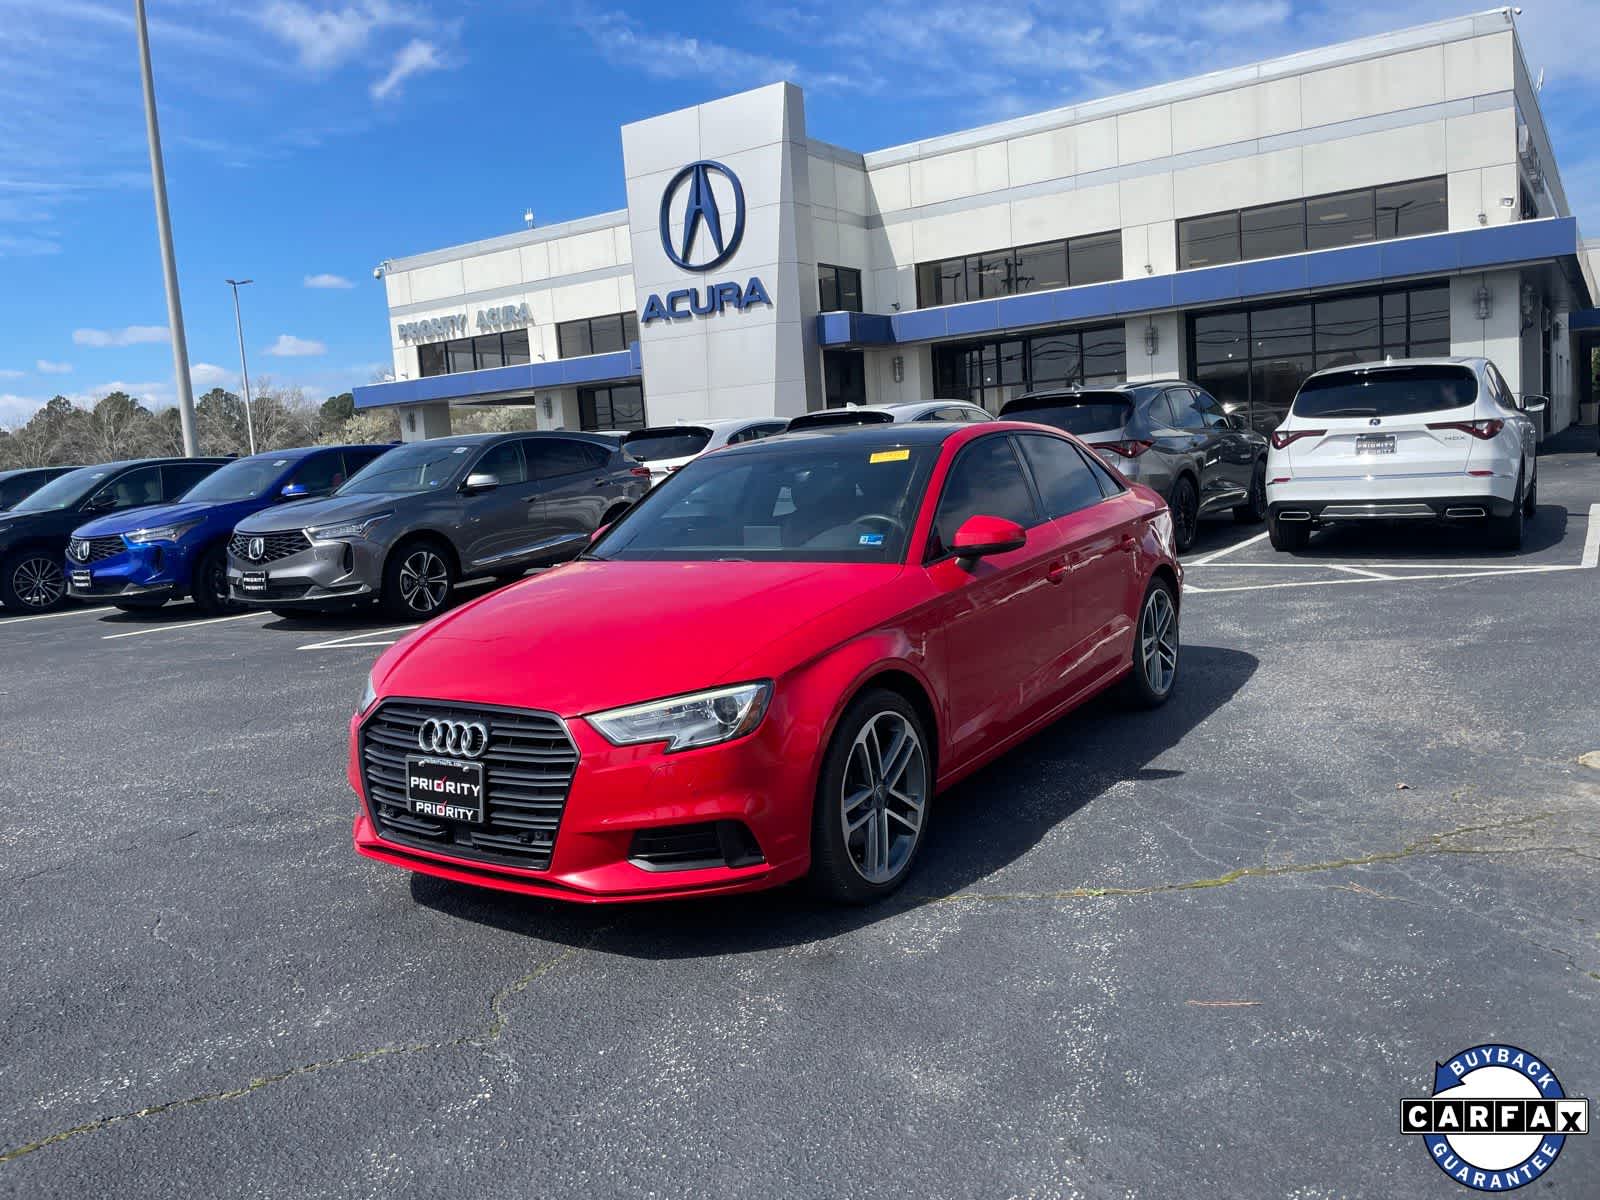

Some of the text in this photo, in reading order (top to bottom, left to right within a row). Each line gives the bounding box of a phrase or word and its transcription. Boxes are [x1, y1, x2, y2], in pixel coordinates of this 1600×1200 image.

[641, 277, 773, 323] ACURA
[397, 302, 534, 341] PRIORITY ACURA
[410, 776, 480, 797] PRIORITY
[415, 802, 474, 820] PRIORITY
